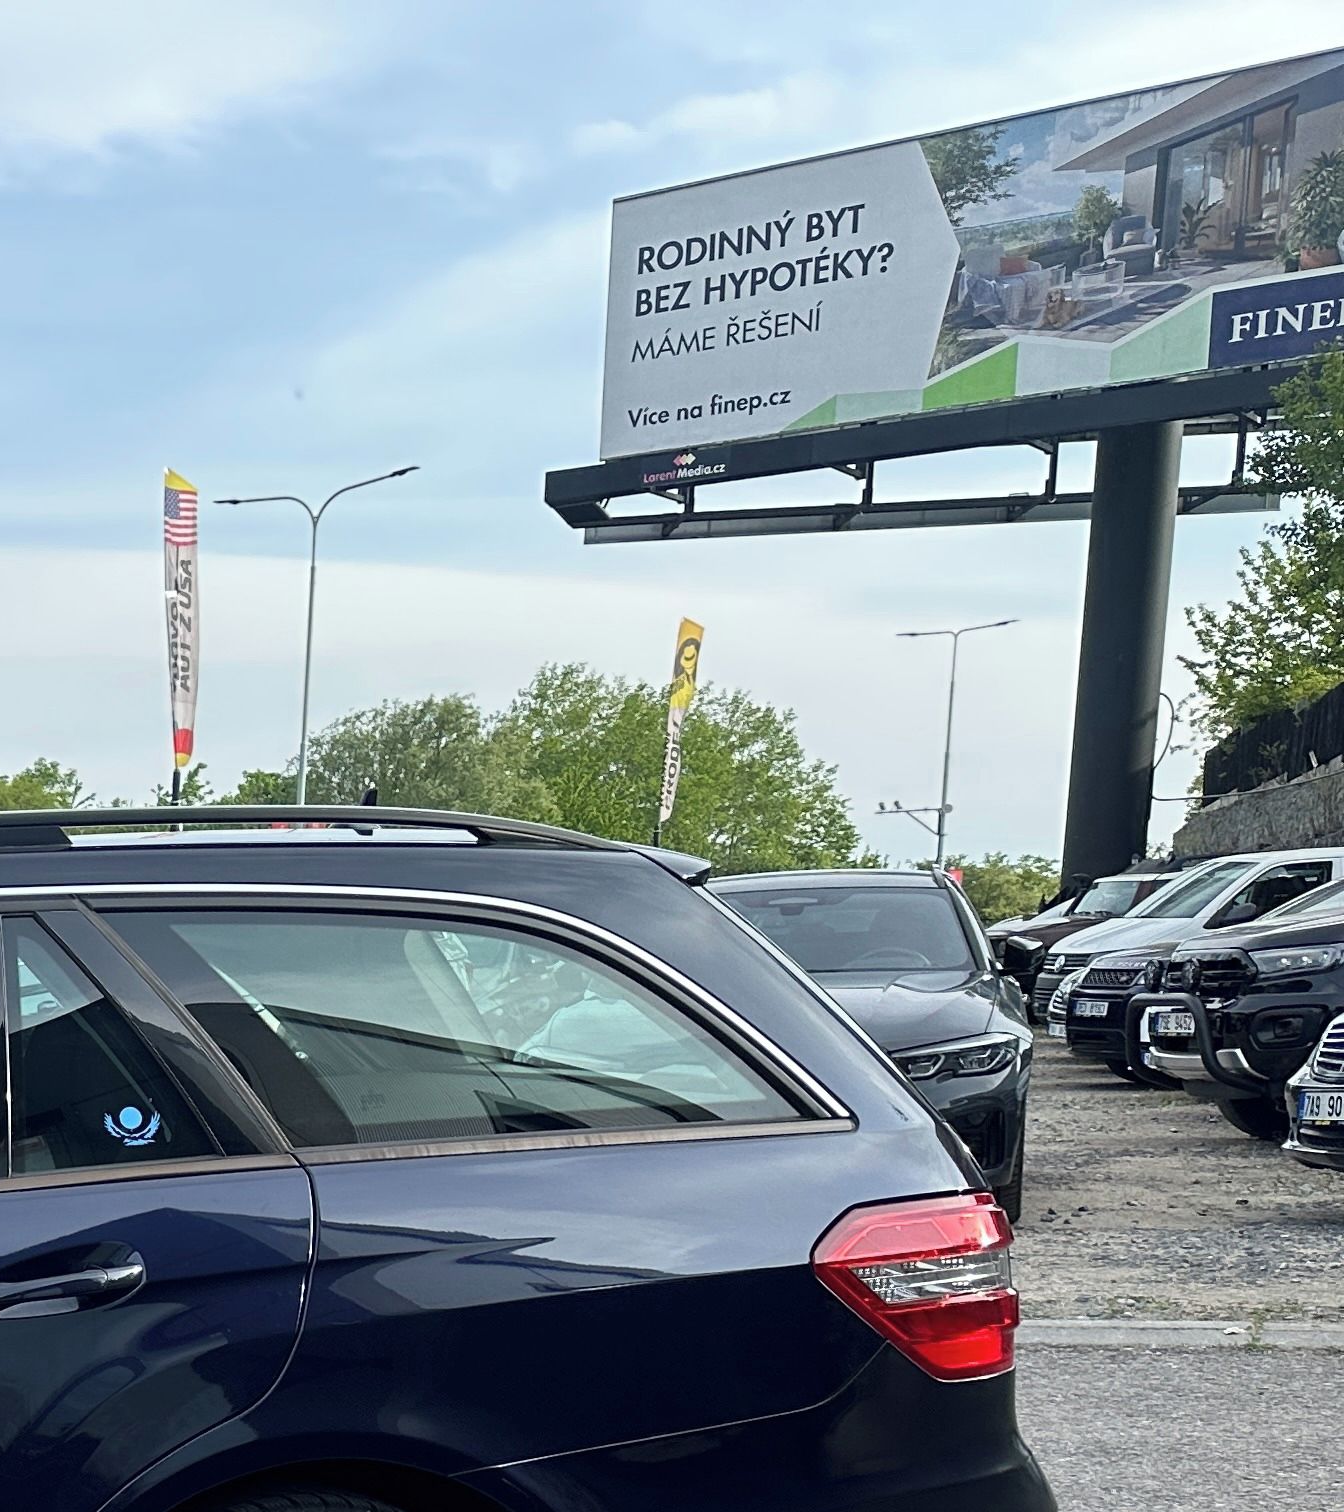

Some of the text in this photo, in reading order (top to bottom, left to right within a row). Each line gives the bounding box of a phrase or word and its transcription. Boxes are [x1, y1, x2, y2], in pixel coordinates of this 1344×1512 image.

[637, 204, 865, 275] RODINNÝ BYT
[635, 242, 894, 317] BEZ HYPOTÉKY?
[631, 301, 823, 363] MÁME ŘEŠENÍ
[628, 390, 792, 428] Více na finep.cz
[180, 559, 192, 693] AUT Z USA
[1327, 1095, 1343, 1117] 90
